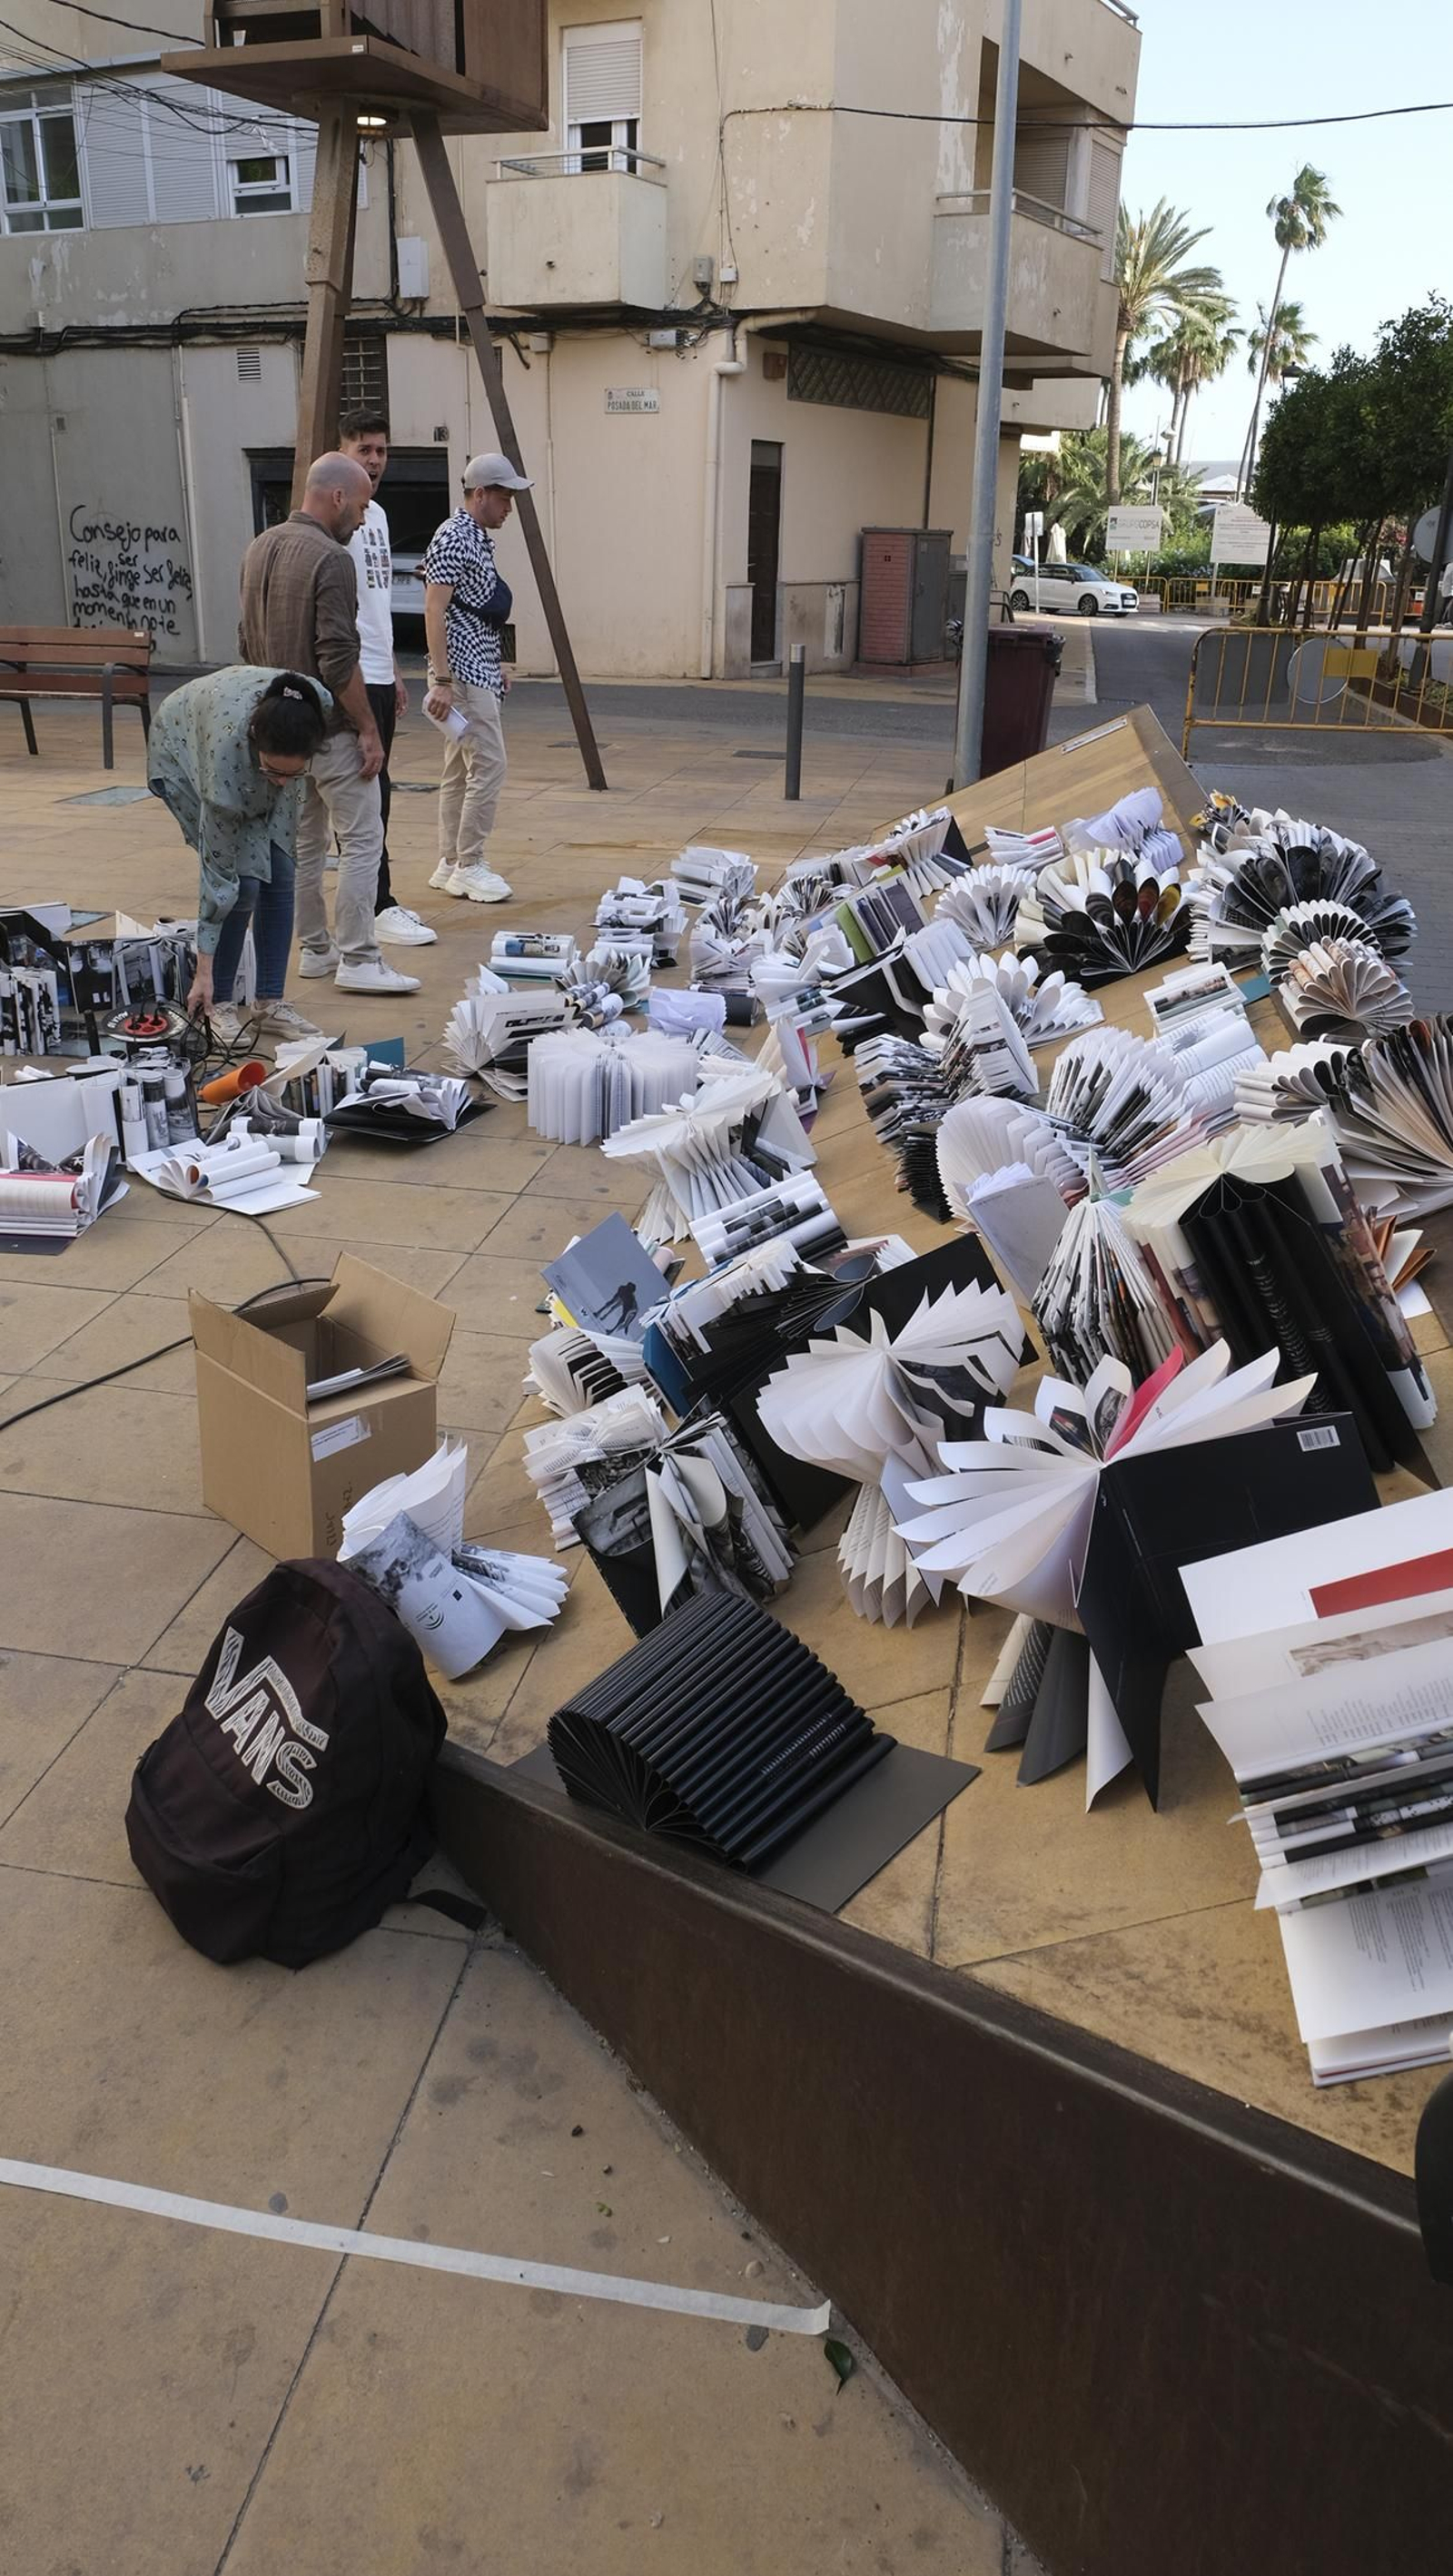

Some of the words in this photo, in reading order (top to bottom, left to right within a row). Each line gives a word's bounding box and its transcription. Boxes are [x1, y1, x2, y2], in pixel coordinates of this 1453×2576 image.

[608, 400, 630, 410] POSADA
[631, 400, 642, 410] DEL
[644, 400, 657, 410] MAR
[70, 505, 141, 552] Consejo
[145, 526, 181, 553] para
[118, 553, 138, 567] ser
[74, 575, 120, 603] hasta
[122, 593, 141, 610] que
[143, 597, 156, 610] en
[159, 598, 176, 614] un
[204, 1626, 330, 1810] VANS
